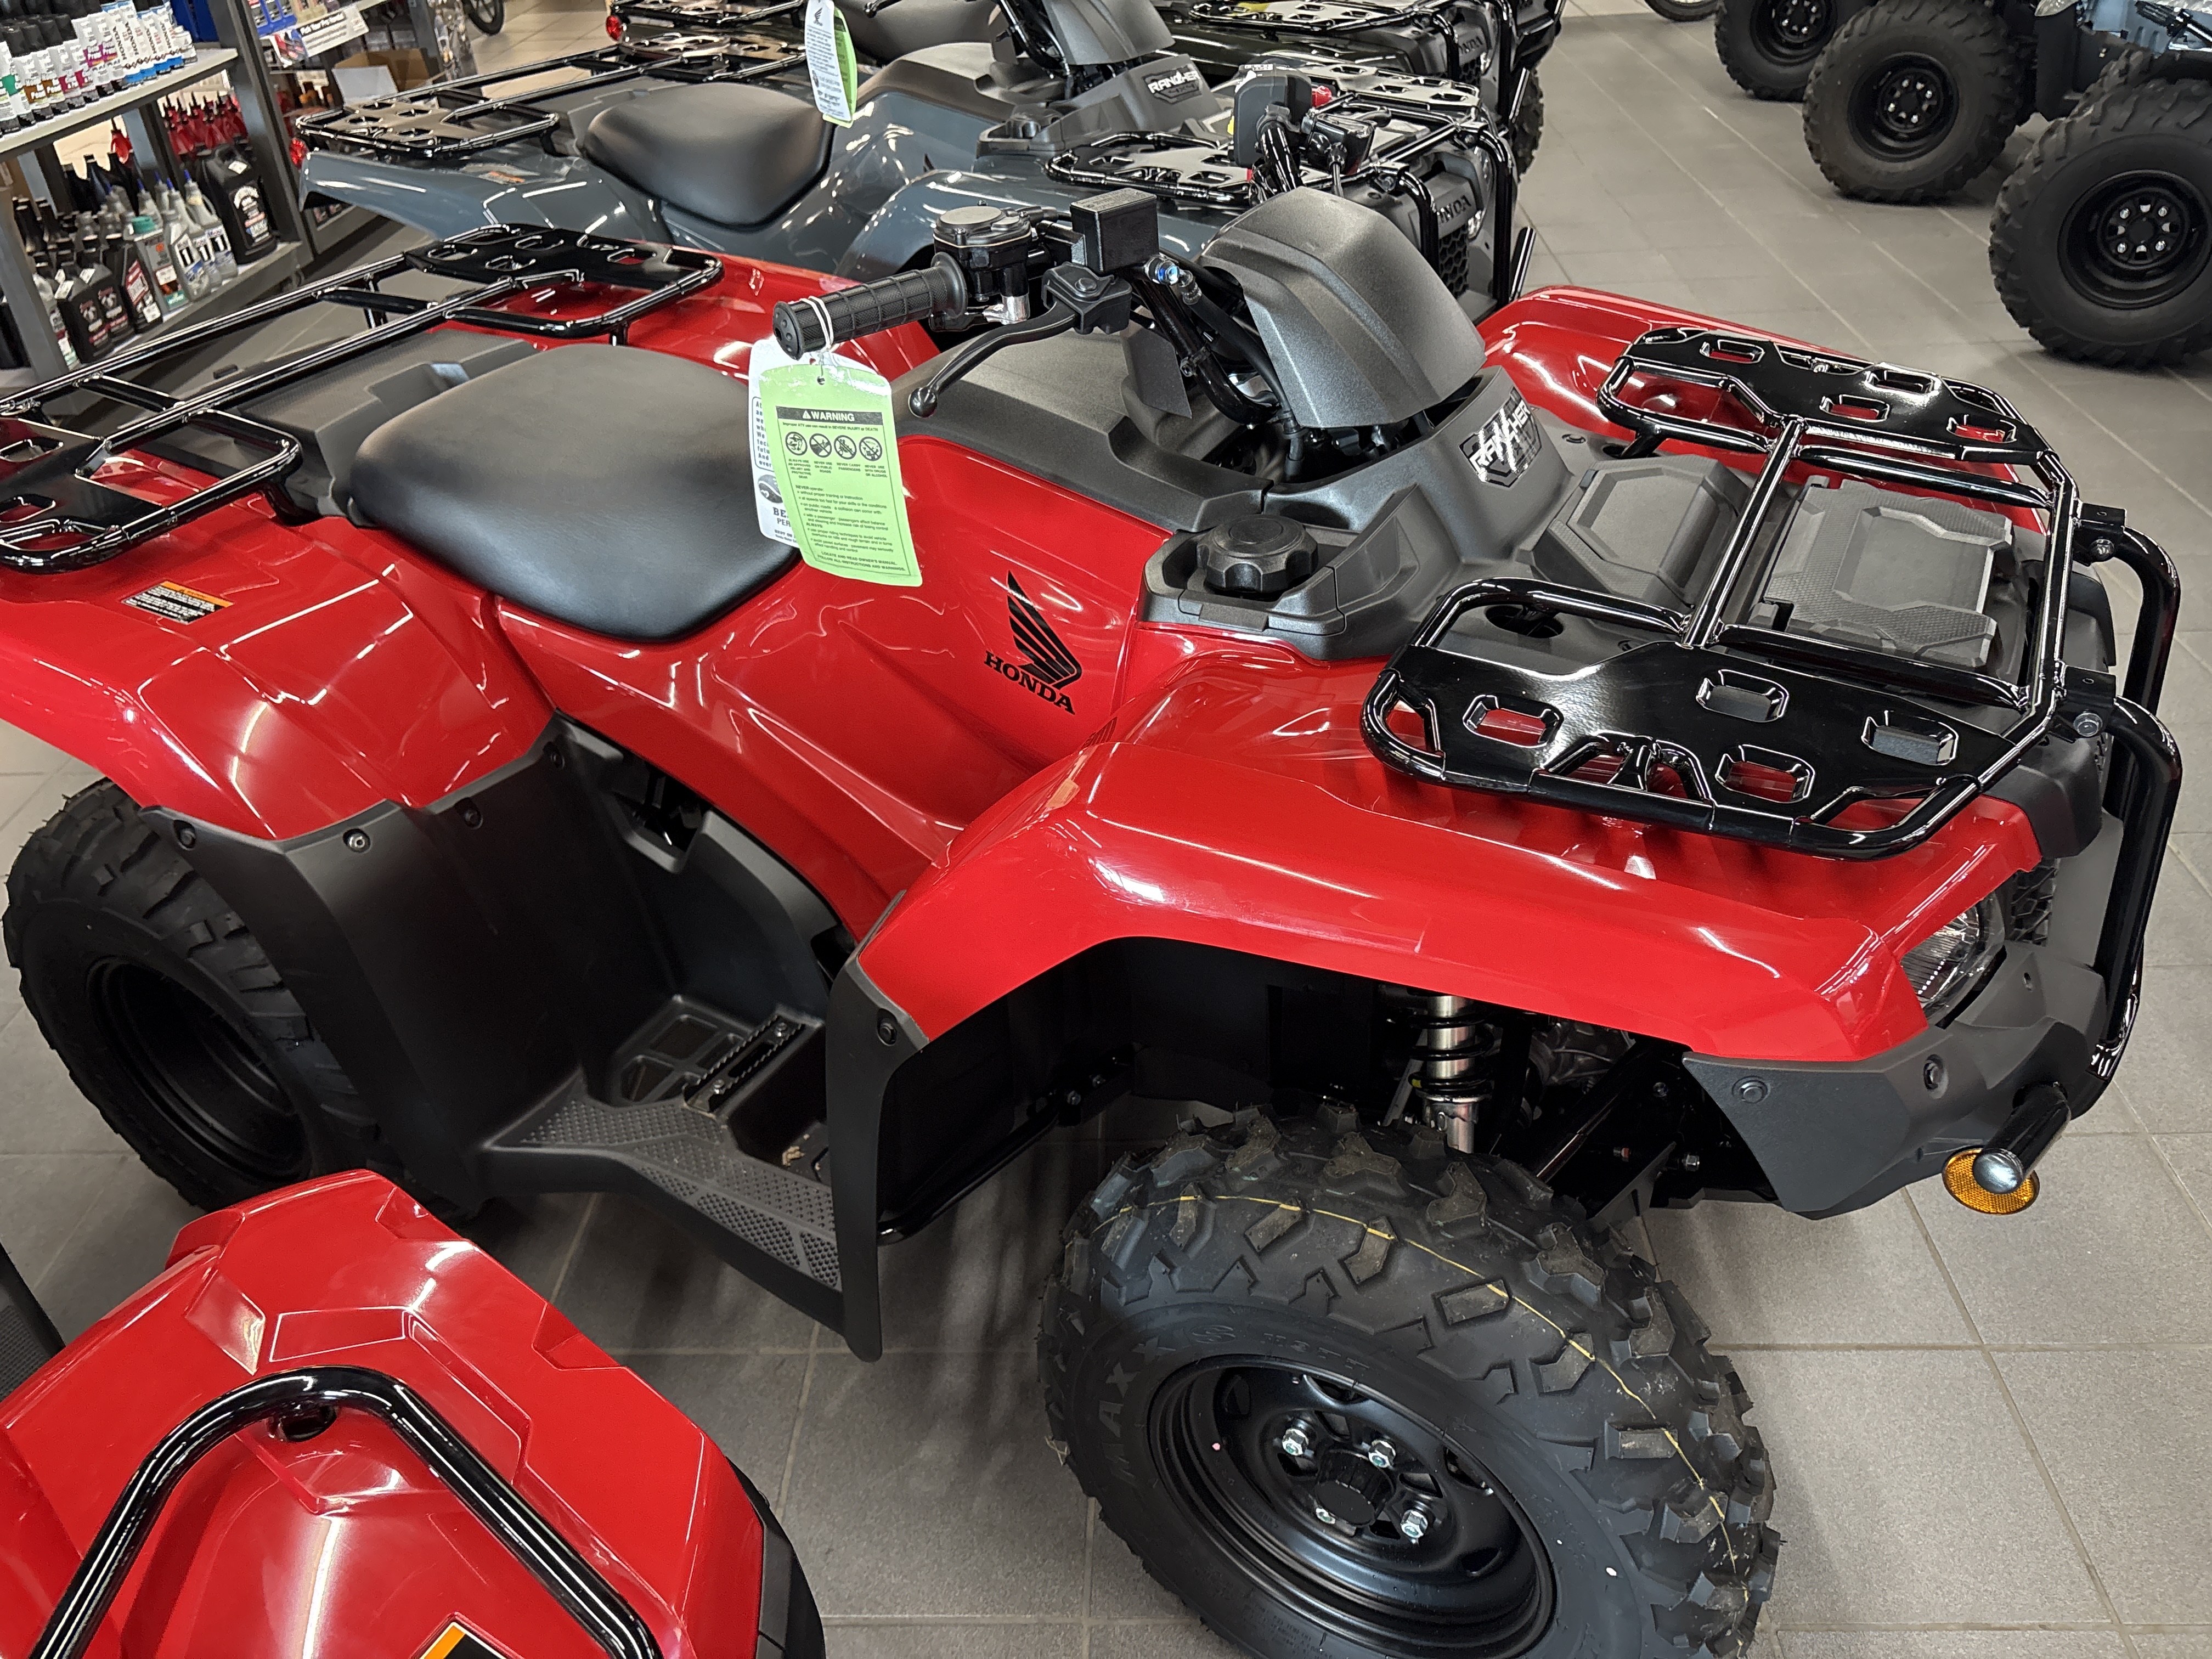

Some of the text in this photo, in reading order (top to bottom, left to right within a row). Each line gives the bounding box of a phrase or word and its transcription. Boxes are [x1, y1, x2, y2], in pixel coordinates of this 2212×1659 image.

[113, 26, 127, 60] HONDA
[125, 22, 139, 55] HONDA
[810, 410, 855, 422] WARNING
[758, 453, 769, 461] And
[772, 506, 789, 519] BE
[984, 650, 1076, 715] HONDA
